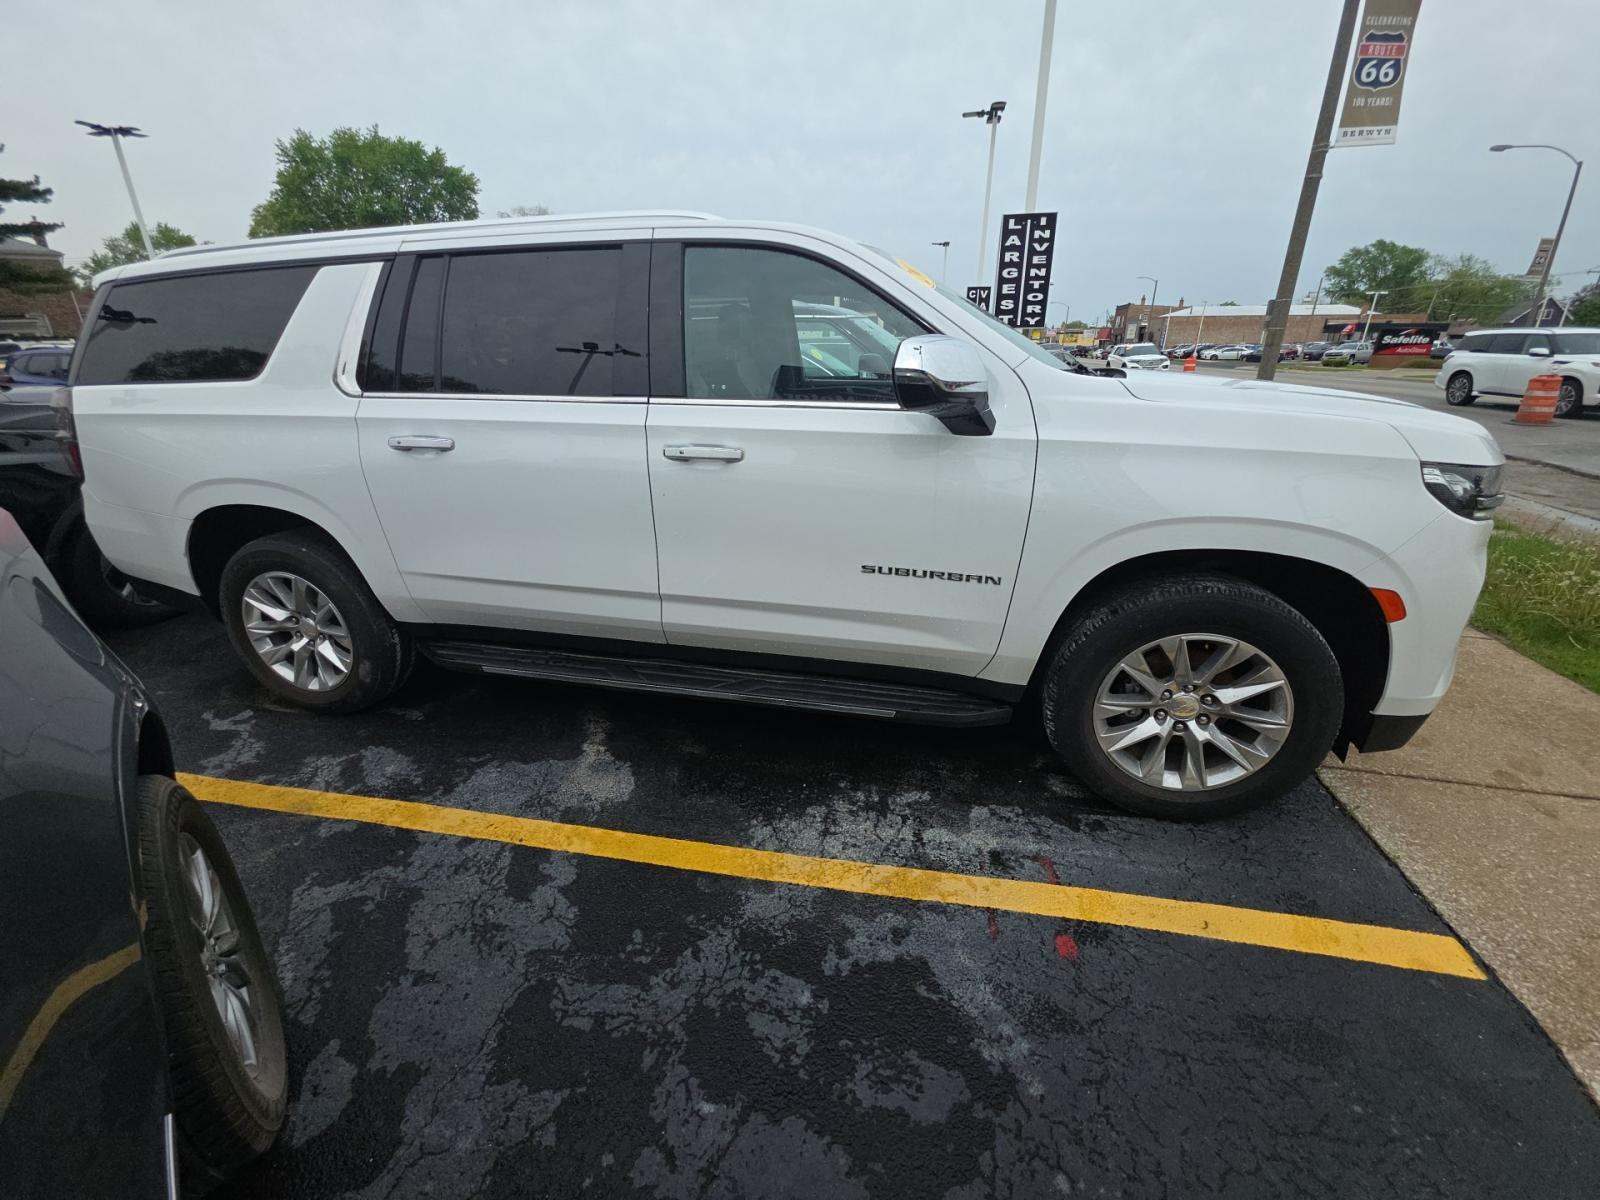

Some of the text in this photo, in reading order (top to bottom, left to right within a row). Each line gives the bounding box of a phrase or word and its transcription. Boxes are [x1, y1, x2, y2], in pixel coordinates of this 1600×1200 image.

[1368, 45, 1397, 56] ROUTE
[1360, 60, 1395, 83] 66
[1342, 128, 1392, 138] BERWYN
[998, 218, 1022, 325] LARGEST
[1024, 216, 1051, 325] INVENTORY
[1381, 335, 1430, 344] Safelite
[860, 564, 1002, 586] SUBURBAN
